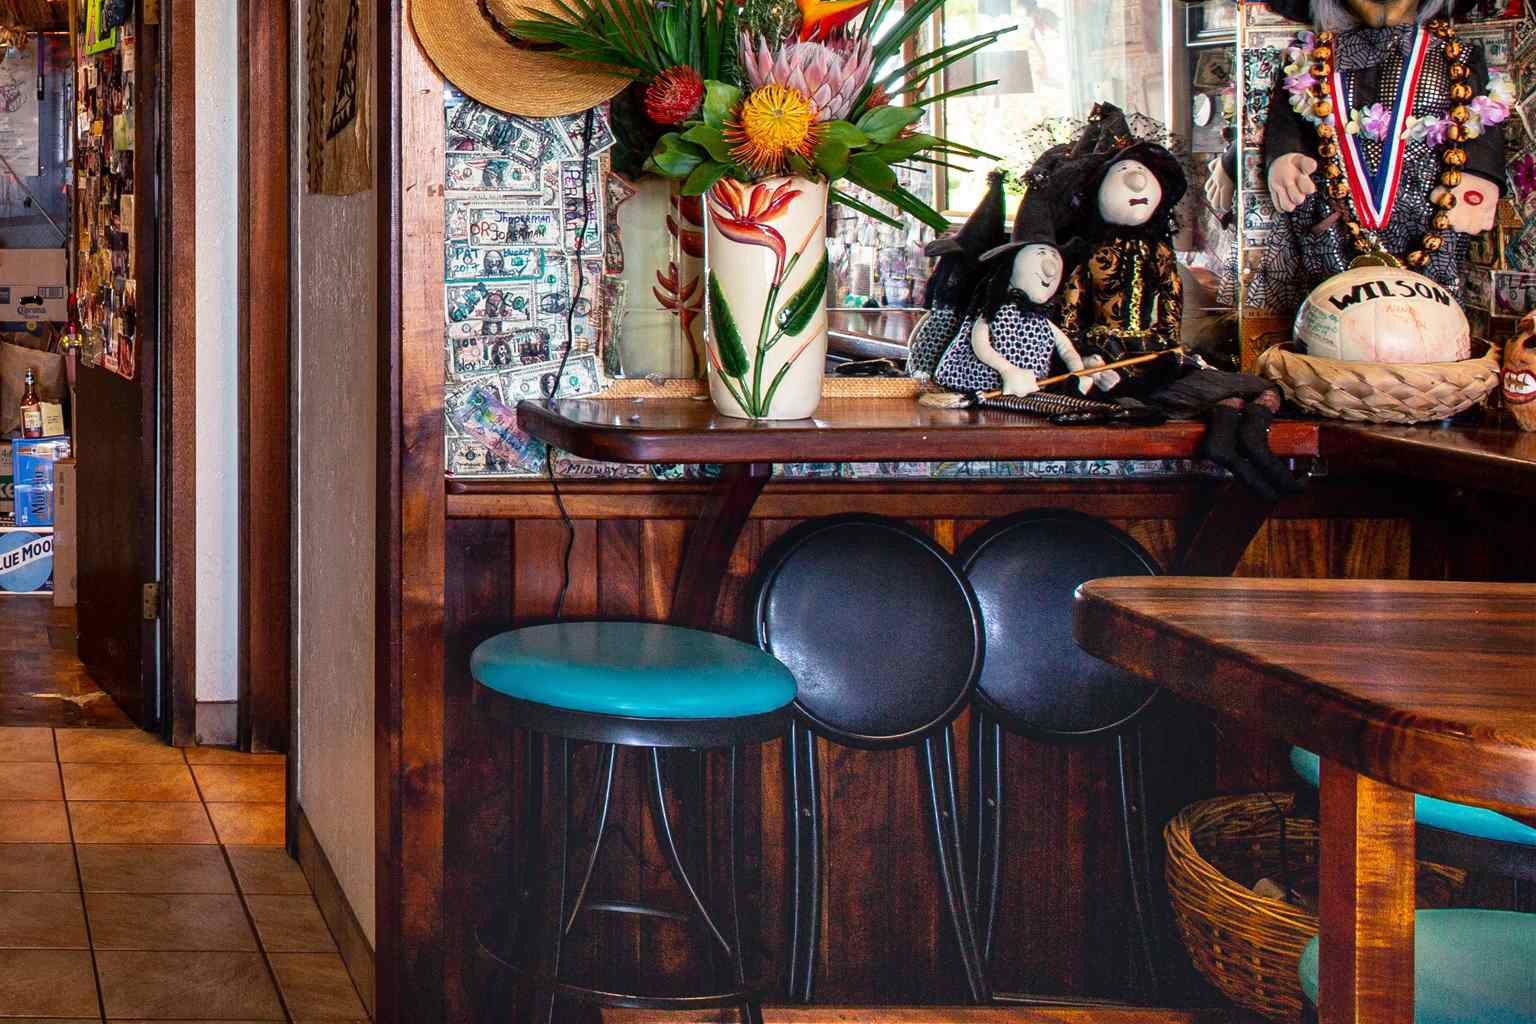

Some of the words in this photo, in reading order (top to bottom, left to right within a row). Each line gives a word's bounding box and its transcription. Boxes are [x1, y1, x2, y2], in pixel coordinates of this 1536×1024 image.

[455, 248, 479, 259] PAT
[1328, 280, 1452, 311] WILSON
[21, 537, 54, 561] MOO
